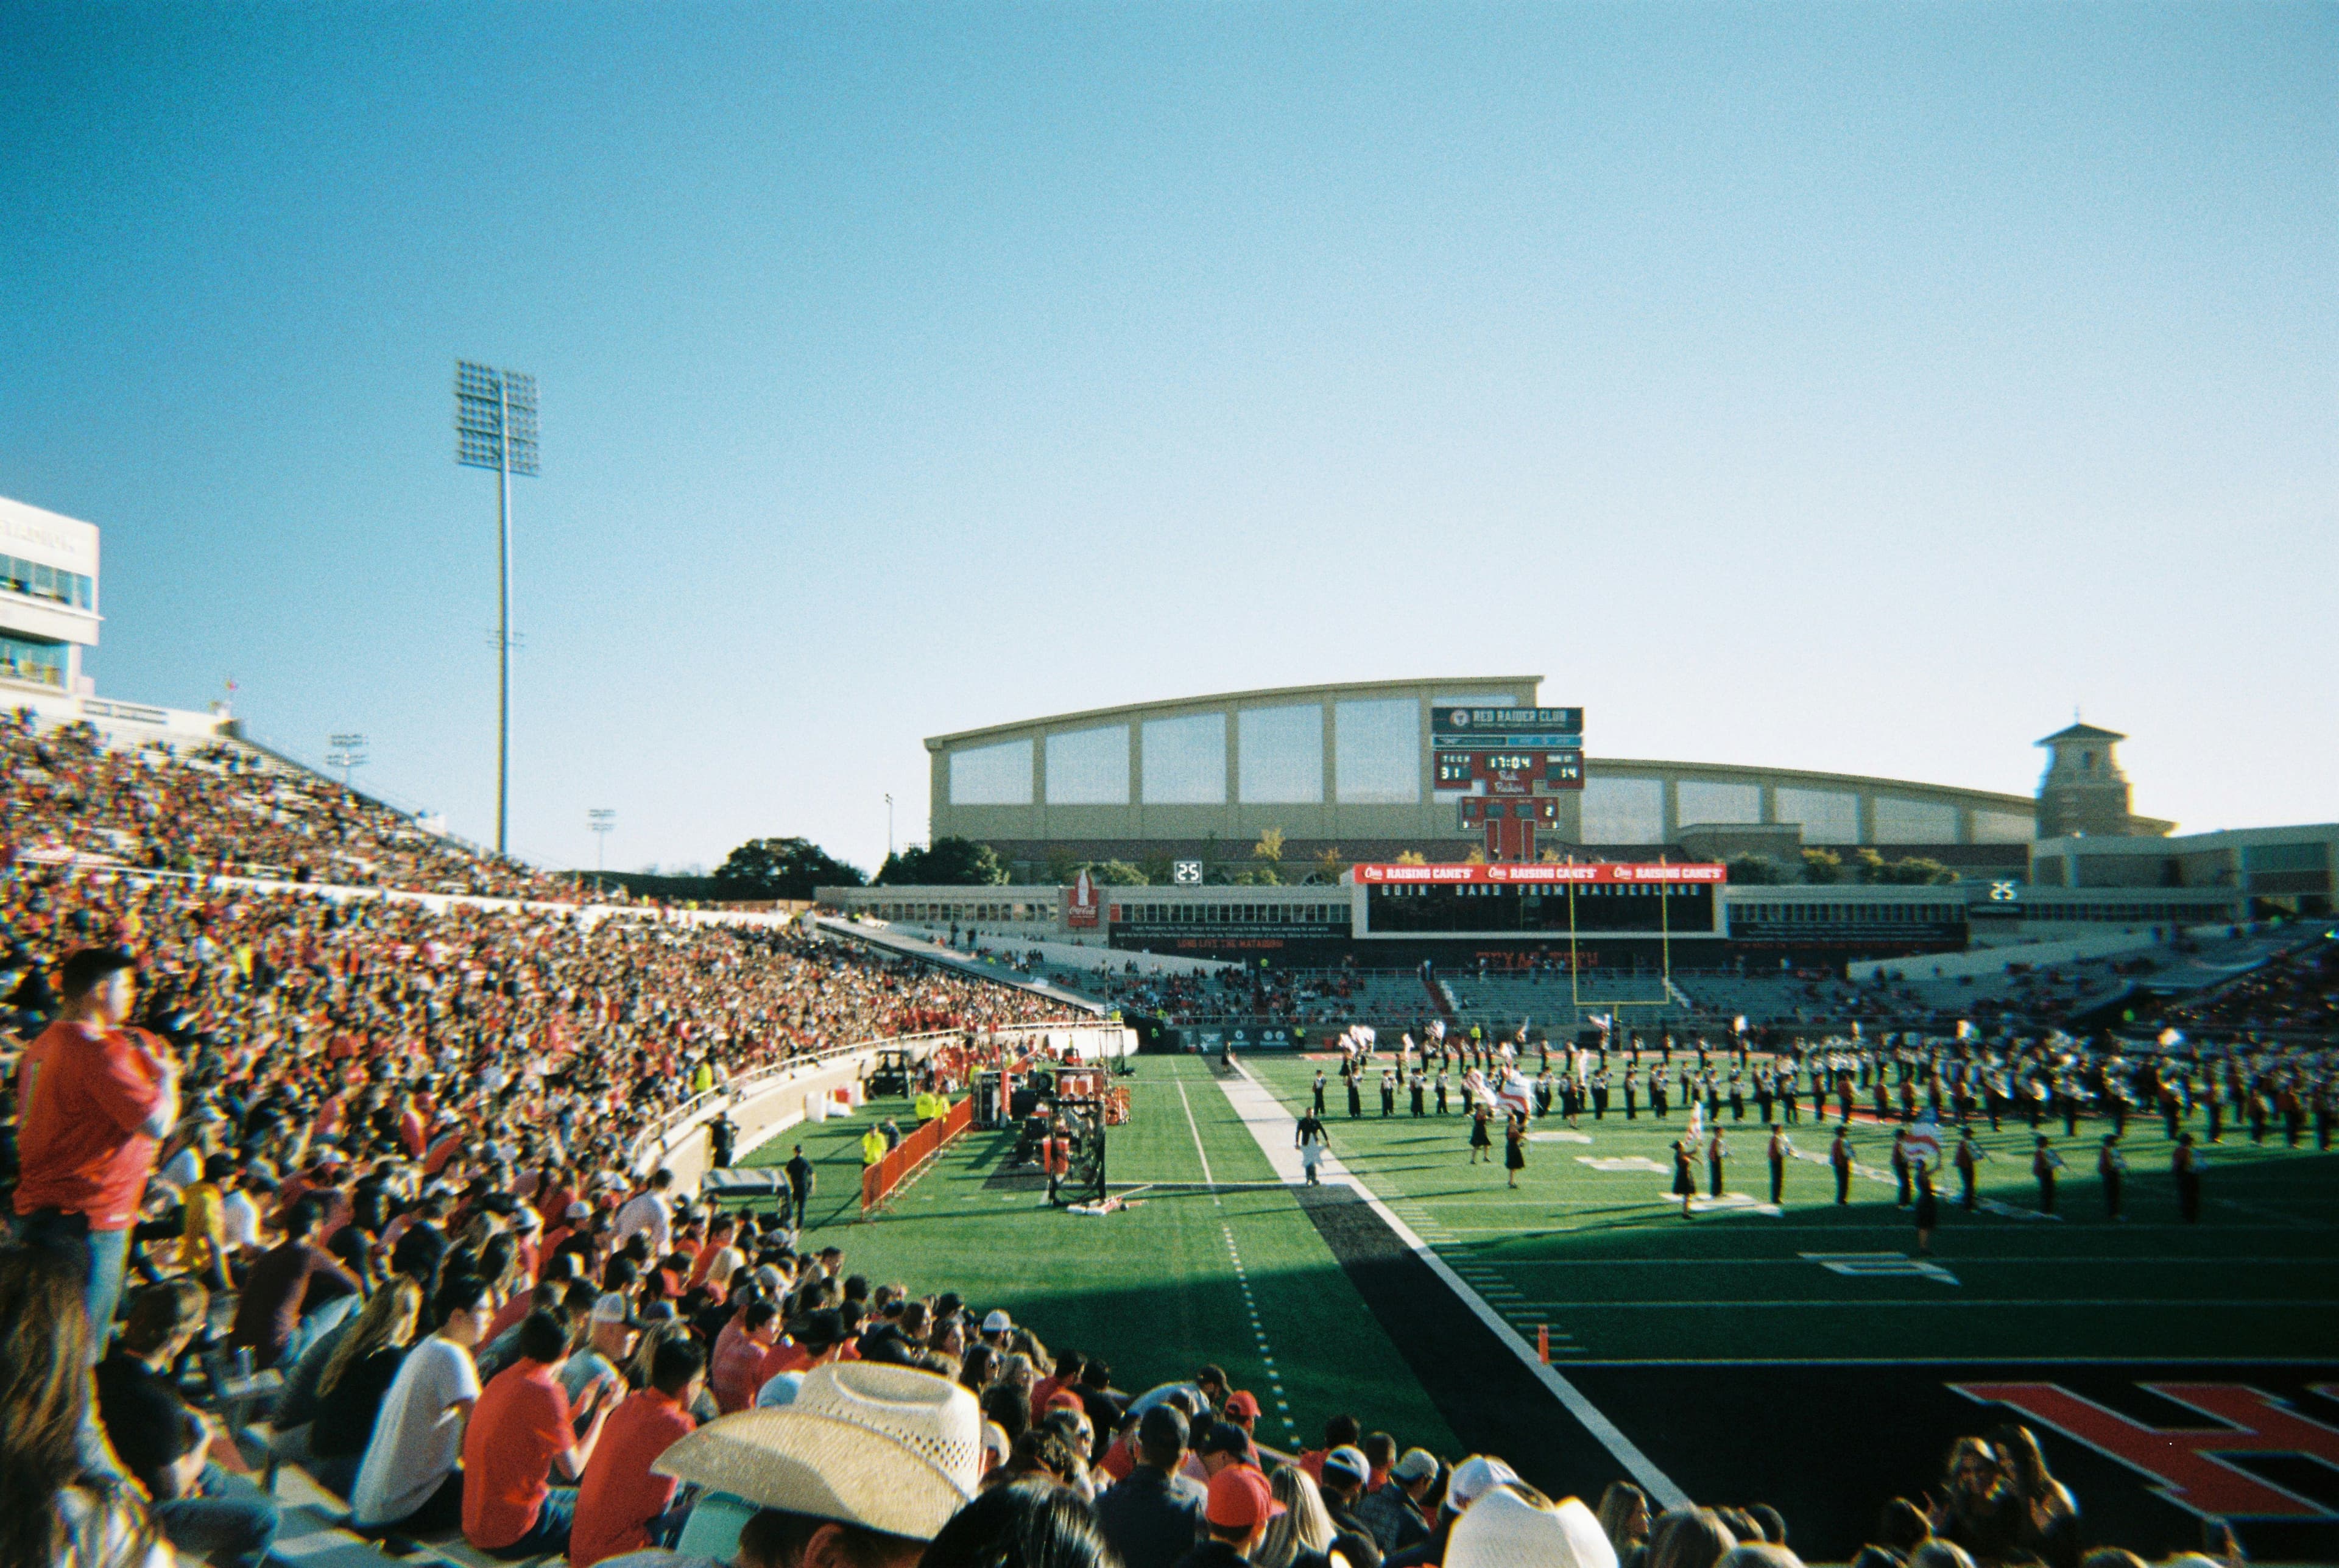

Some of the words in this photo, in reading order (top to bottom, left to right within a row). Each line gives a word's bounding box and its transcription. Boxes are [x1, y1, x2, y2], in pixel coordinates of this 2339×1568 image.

[1473, 710, 1494, 722] RED
[1497, 710, 1537, 722] RAIDER
[1539, 710, 1567, 722] CLUB
[1490, 756, 1530, 769] 17:04
[1441, 766, 1459, 779] 31
[1561, 768, 1576, 778] 14
[1545, 805, 1553, 817] 2
[1176, 864, 1199, 881] 25
[1386, 867, 1431, 878] RAISING
[1433, 867, 1472, 878] CANE'S
[1510, 867, 1554, 878] RAISING
[1635, 867, 1680, 878] RAISING
[1682, 867, 1721, 878] CANE'S
[1456, 885, 1501, 895] BAND
[1518, 885, 1564, 895] FROM
[1579, 885, 1699, 895] RAIDERLAND
